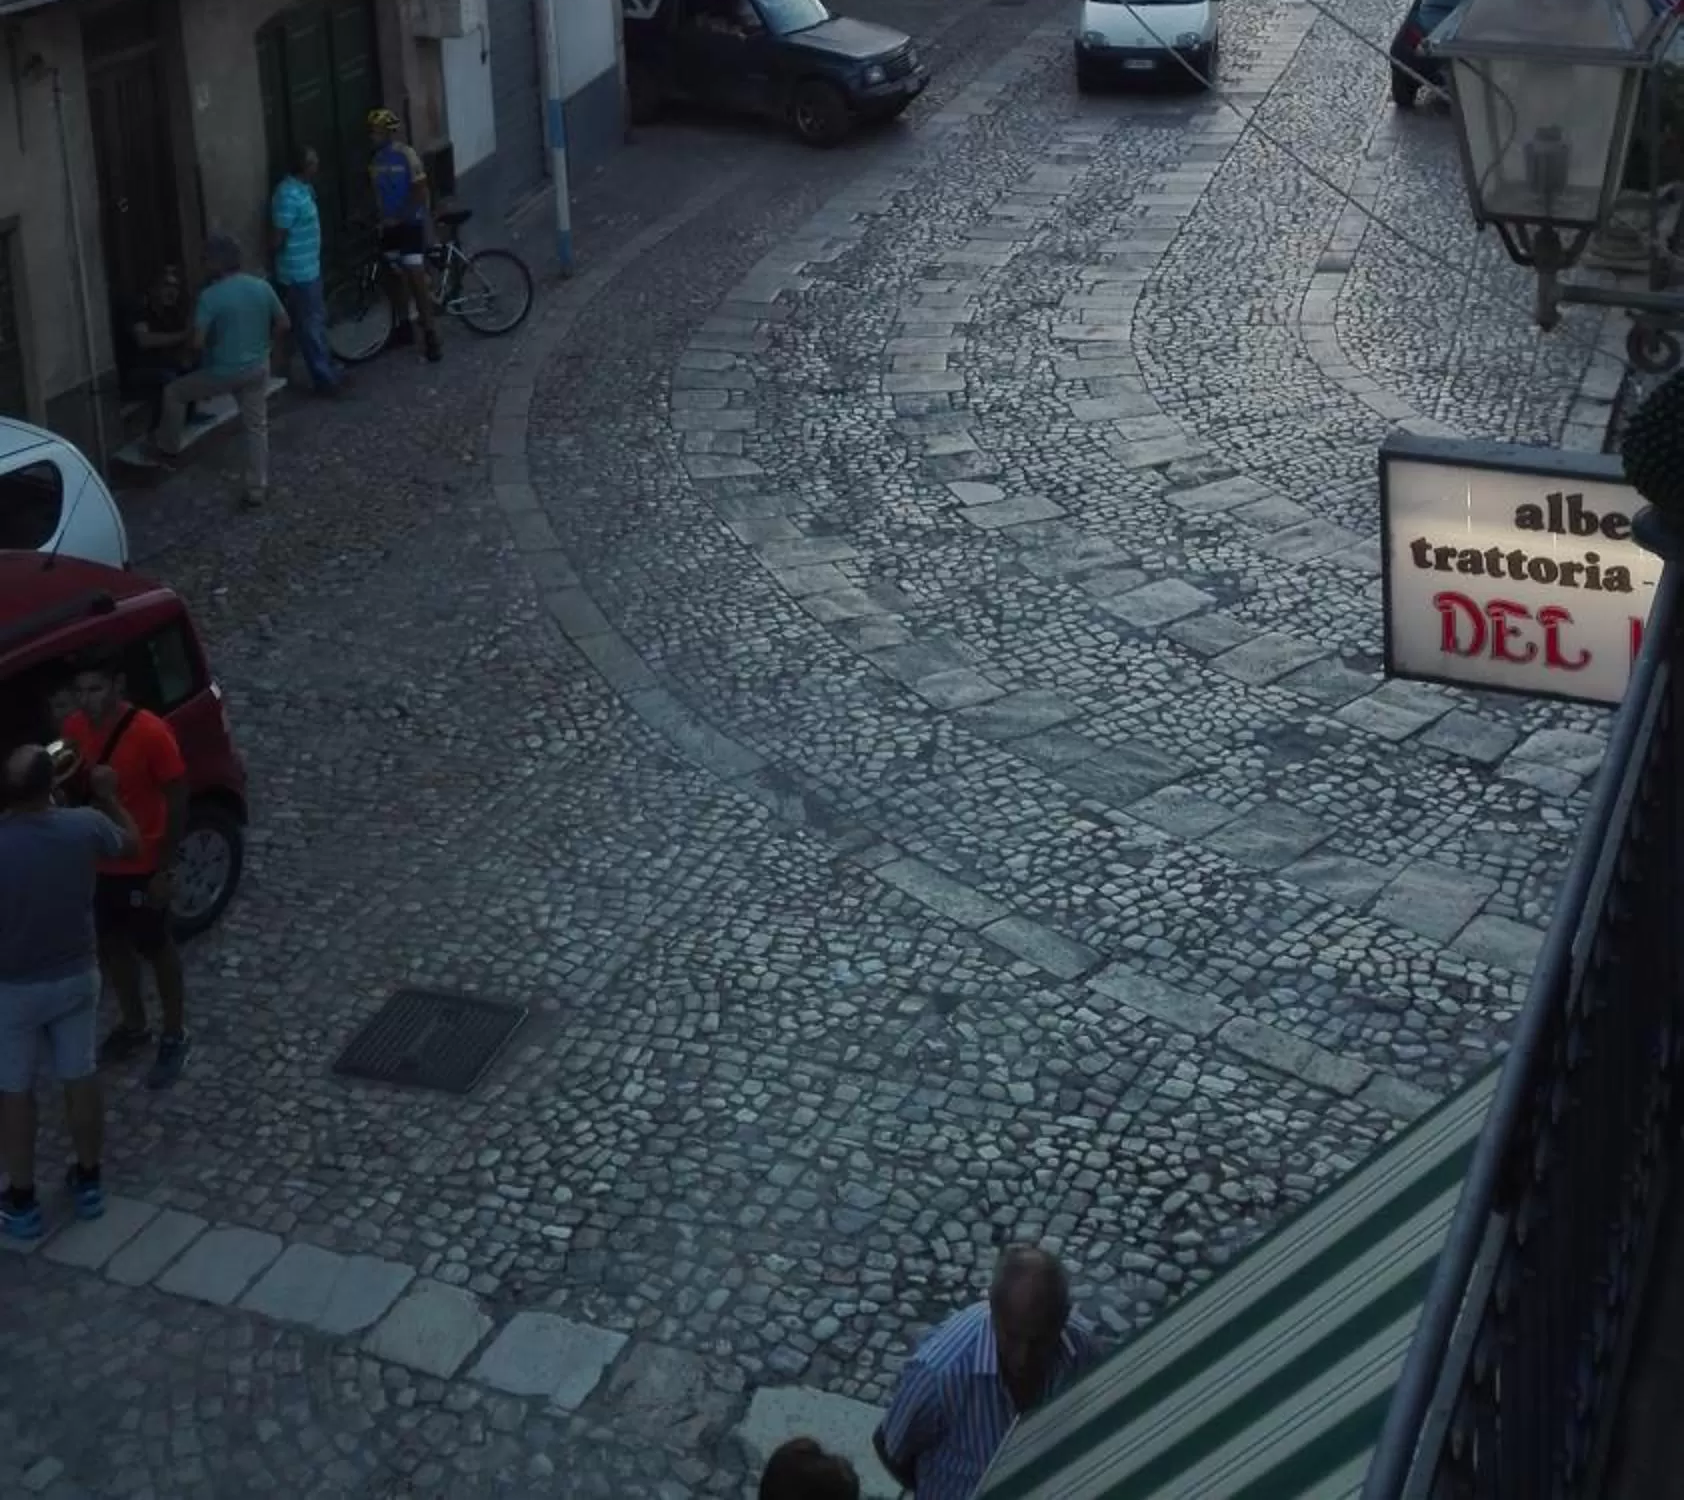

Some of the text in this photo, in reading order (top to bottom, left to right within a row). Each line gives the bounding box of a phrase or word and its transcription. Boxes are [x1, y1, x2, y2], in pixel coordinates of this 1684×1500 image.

[1514, 492, 1632, 540] albe
[1409, 536, 1634, 593] trattoria
[1432, 590, 1592, 672] DEL
